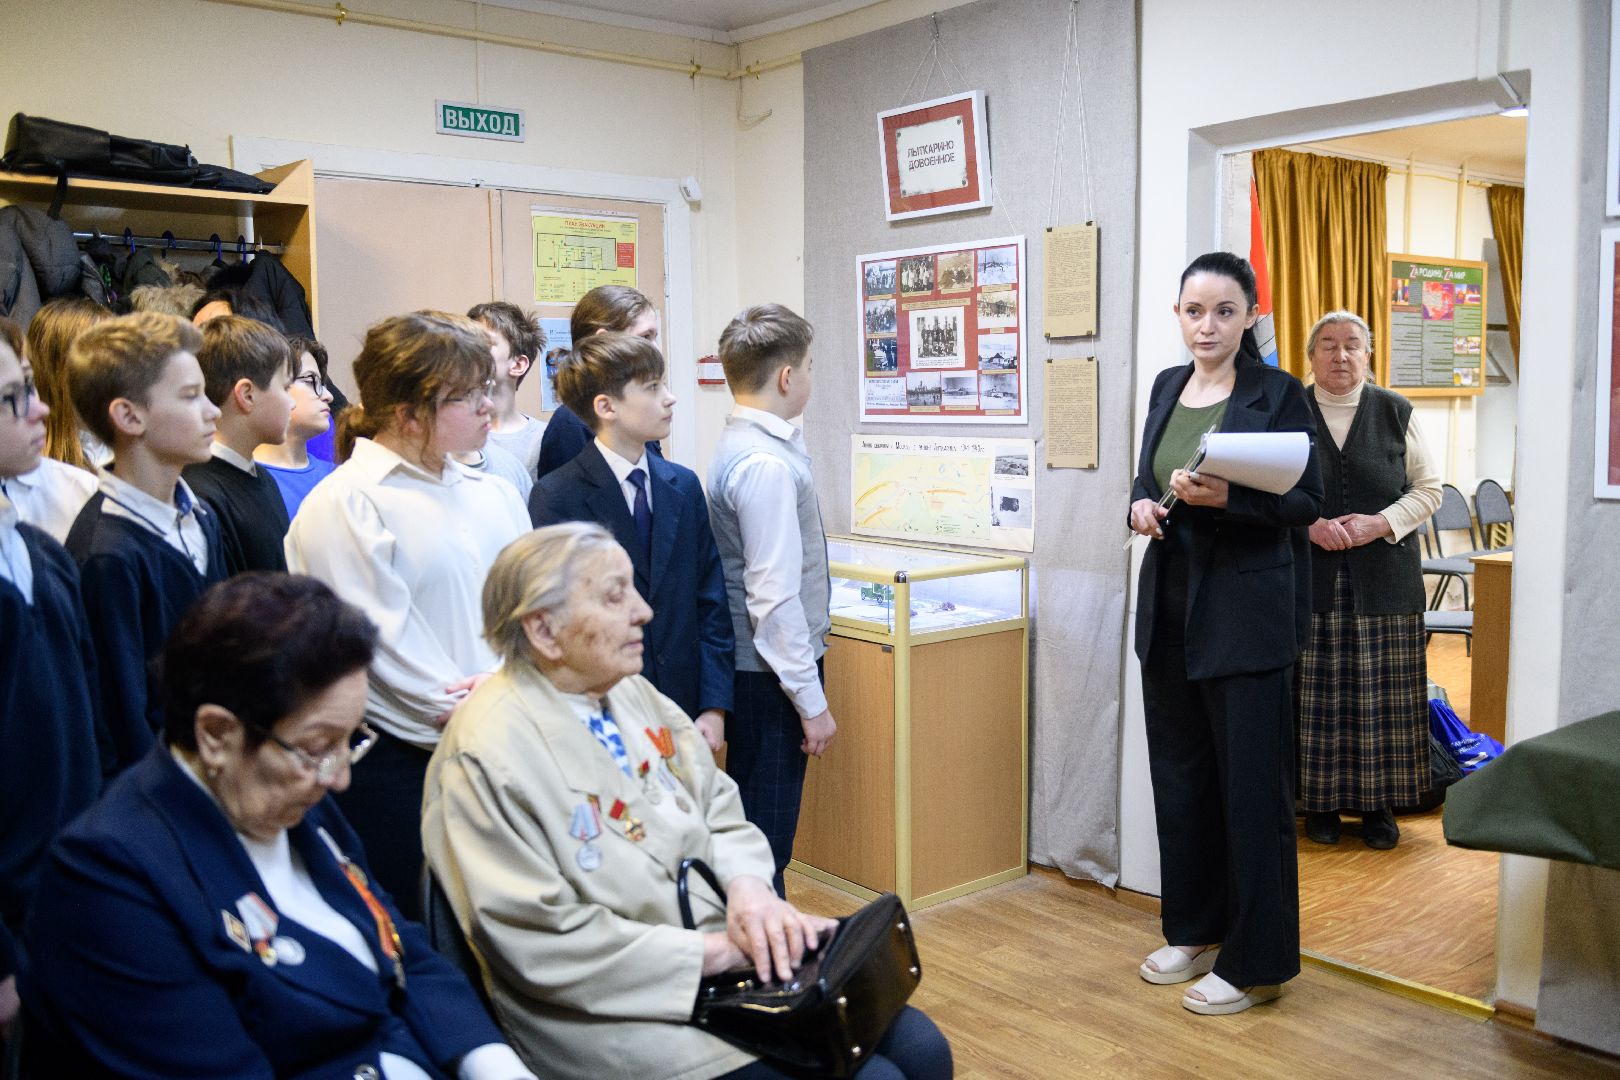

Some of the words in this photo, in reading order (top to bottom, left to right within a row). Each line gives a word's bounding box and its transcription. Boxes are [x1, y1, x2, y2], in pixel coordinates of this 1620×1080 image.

[445, 108, 516, 136] ВЫХОД
[907, 140, 955, 158] ЛЫТКАРИНО
[908, 152, 956, 172] ДОВОЕННОЕ
